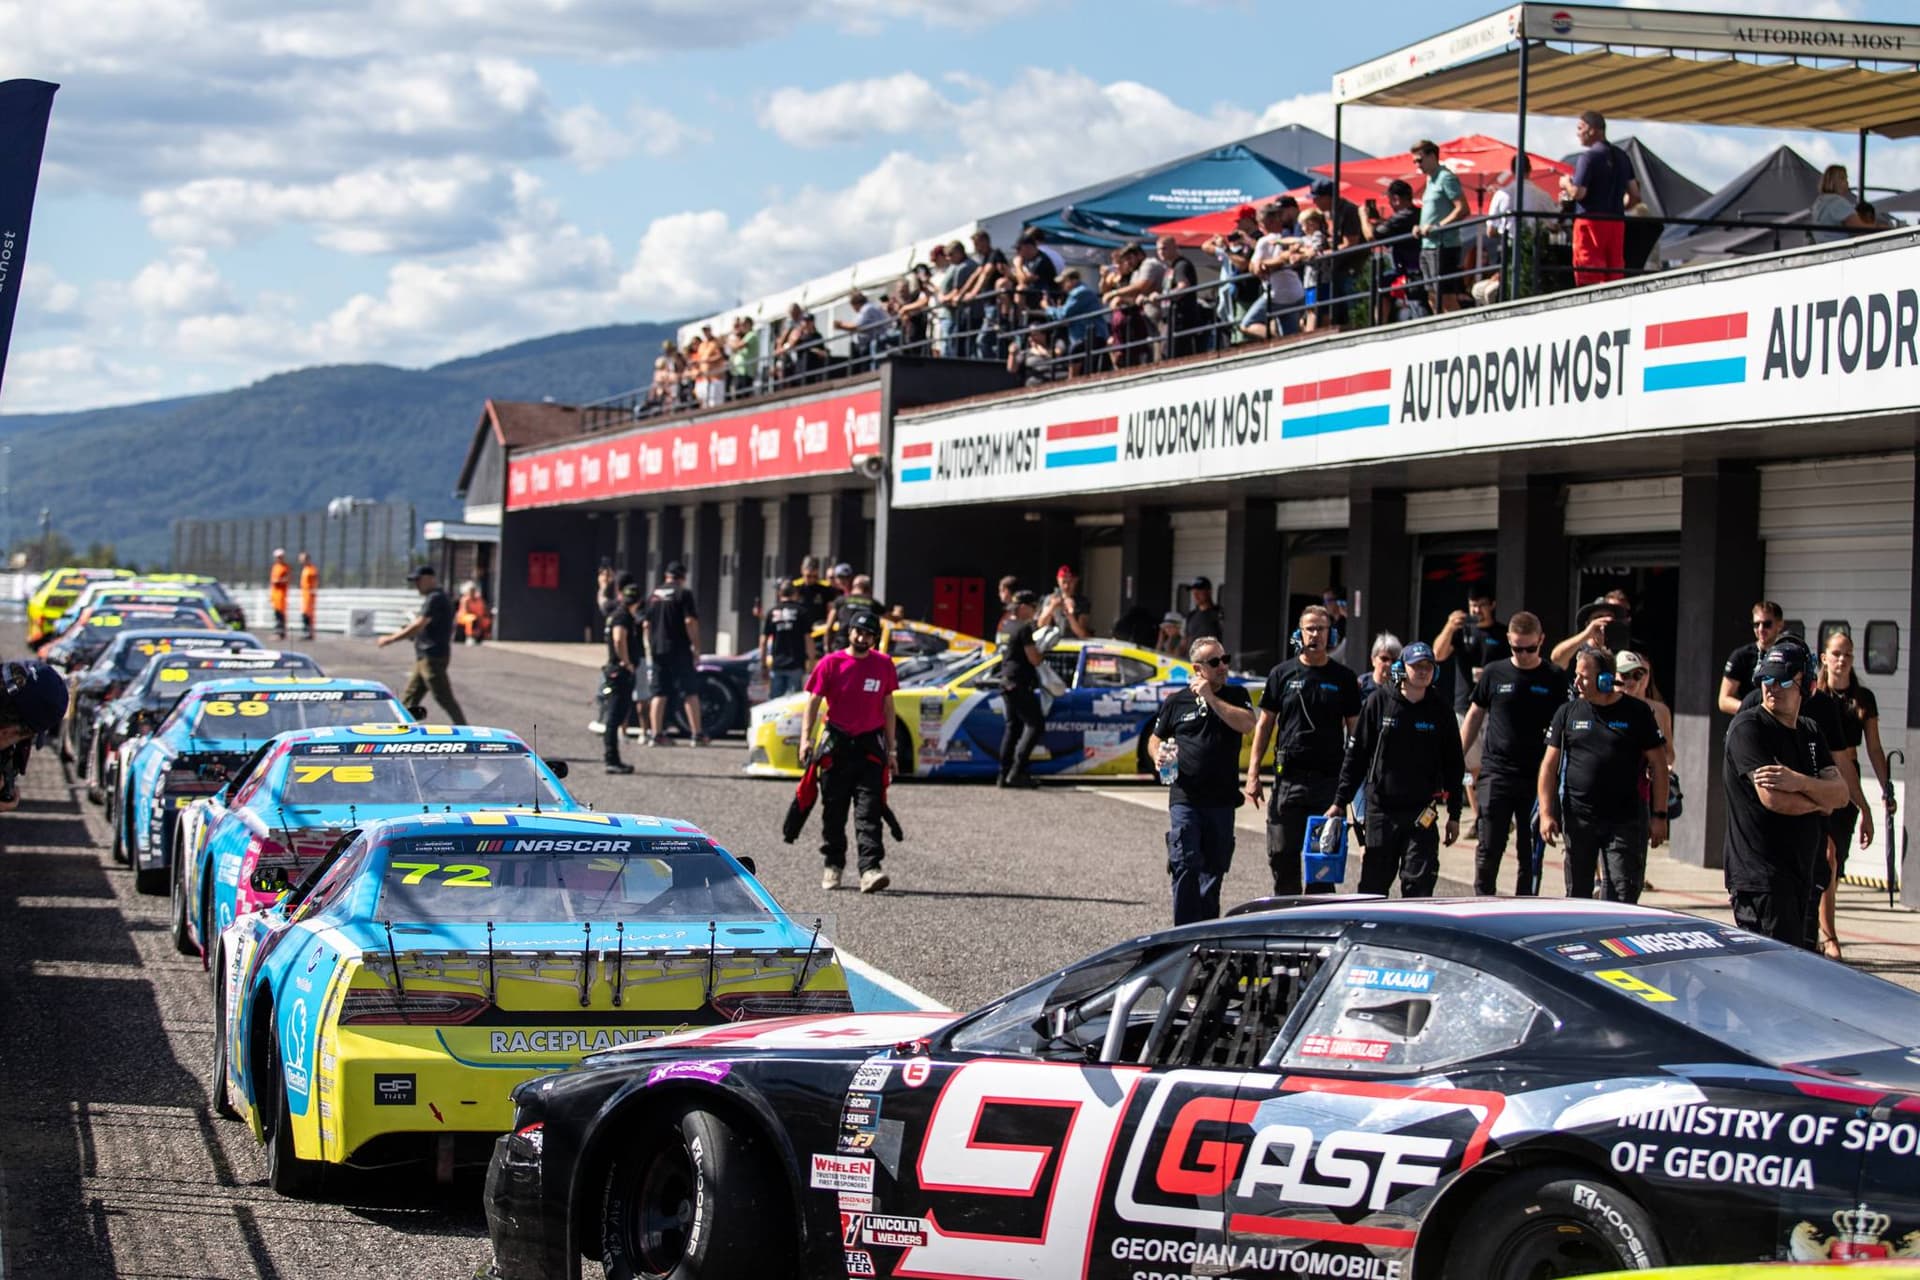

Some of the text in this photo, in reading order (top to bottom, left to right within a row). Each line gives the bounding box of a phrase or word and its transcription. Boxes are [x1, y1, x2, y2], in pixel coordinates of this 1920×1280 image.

[1733, 26, 1906, 51] AUTODROM MOST
[1400, 328, 1631, 424] AUTODROM MOST
[1124, 388, 1273, 461] AUTODROM MOST
[936, 430, 1001, 481] AUTODROM
[1005, 427, 1042, 473] MOST
[275, 692, 344, 701] NASCAR
[863, 679, 881, 692] 21
[205, 701, 269, 717] 69
[382, 743, 467, 753] NASCAR
[294, 766, 374, 783] 76
[515, 840, 632, 852] NASCAR
[391, 862, 492, 887] 72
[1626, 931, 1726, 954] NASCAR
[1366, 970, 1379, 984] D.
[1593, 969, 1679, 1002] 9
[1617, 1104, 1784, 1142] MINISTRY
[1788, 1113, 1839, 1147] OF
[815, 1156, 872, 1175] WHELEN
[1155, 1096, 1454, 1211] GASF
[885, 1058, 1151, 1280] 9
[1610, 1141, 1816, 1191] OF GEORGIA
[866, 1216, 918, 1232] LINCOLN
[877, 1232, 922, 1245] WELDERS
[1111, 1237, 1403, 1280] GEORGIAN AUTOMOBILE
